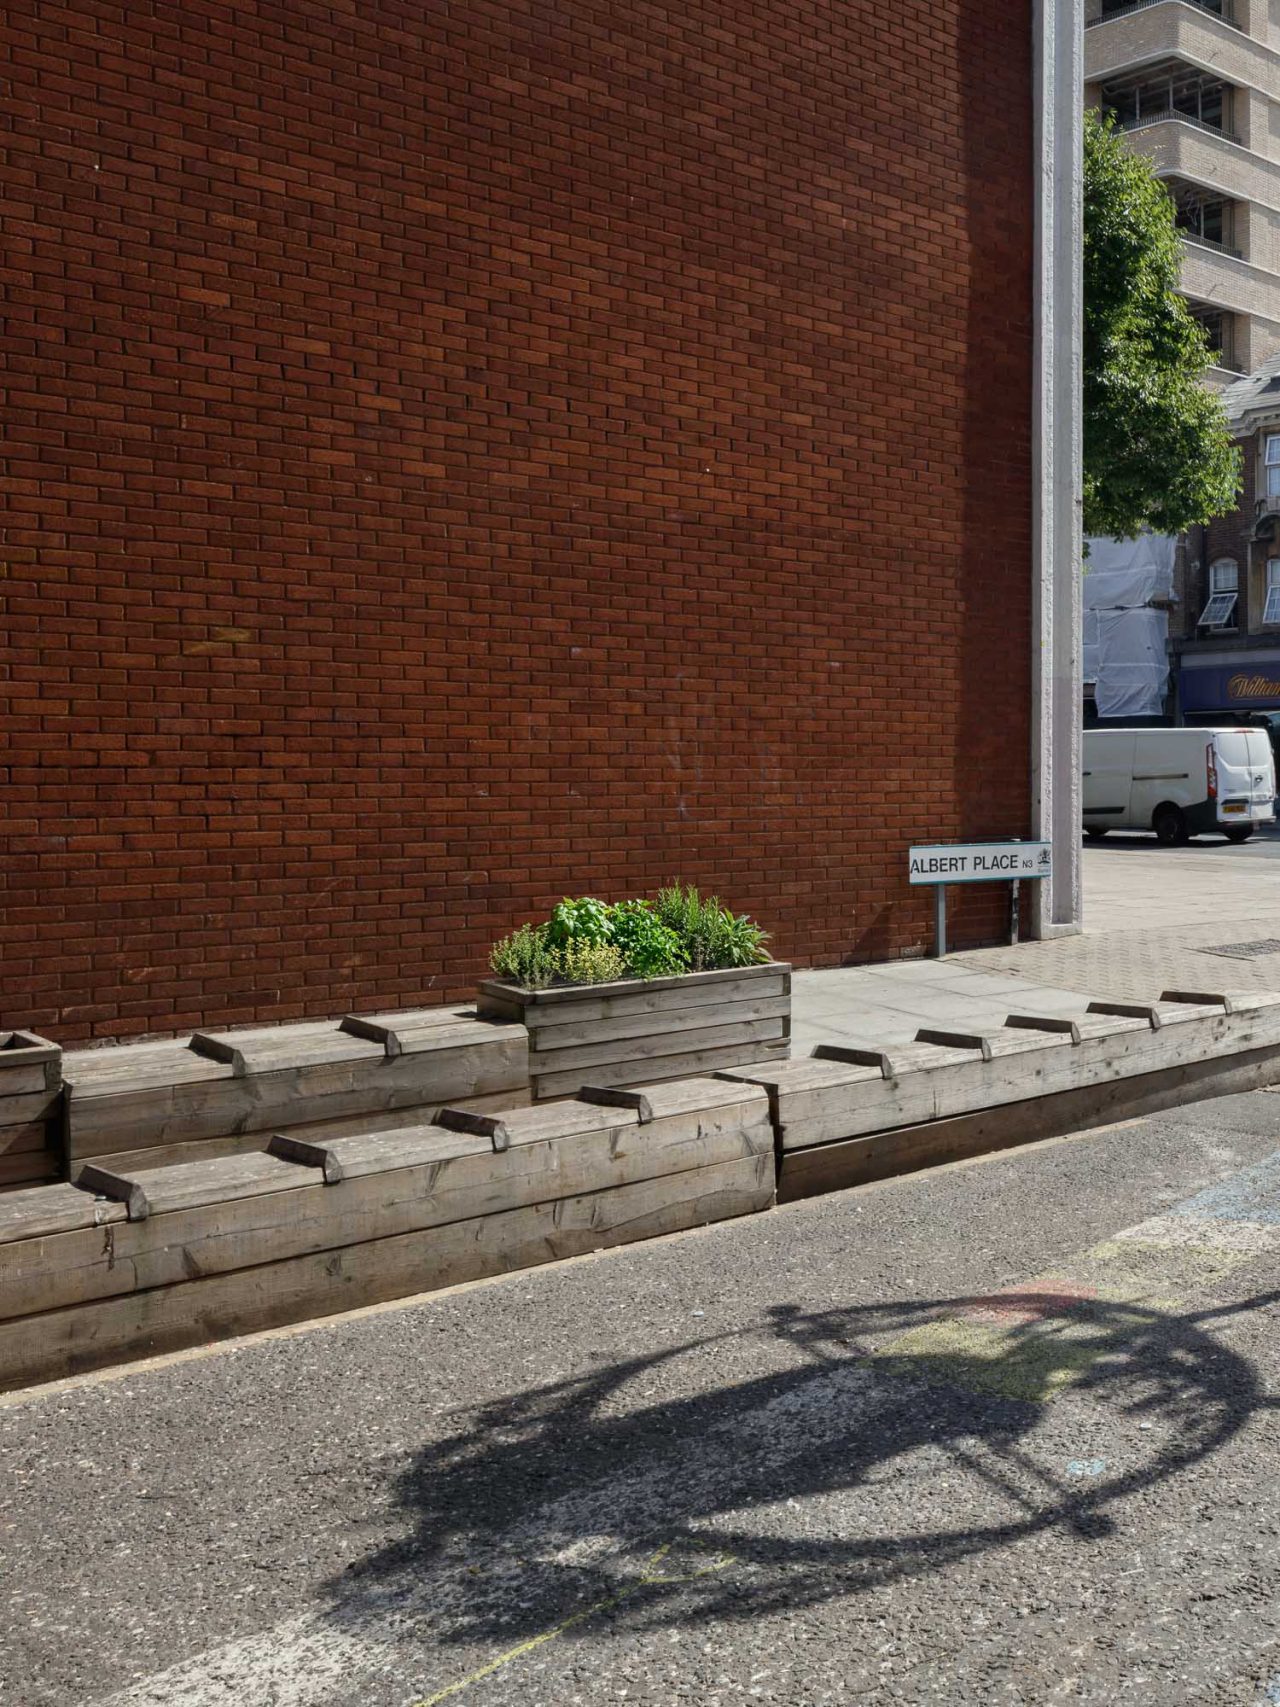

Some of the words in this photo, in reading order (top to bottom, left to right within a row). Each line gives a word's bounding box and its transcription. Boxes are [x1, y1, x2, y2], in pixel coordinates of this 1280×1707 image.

[910, 857, 967, 874] ALBERT
[973, 854, 1019, 871] PLACE
[1022, 860, 1033, 868] N3
